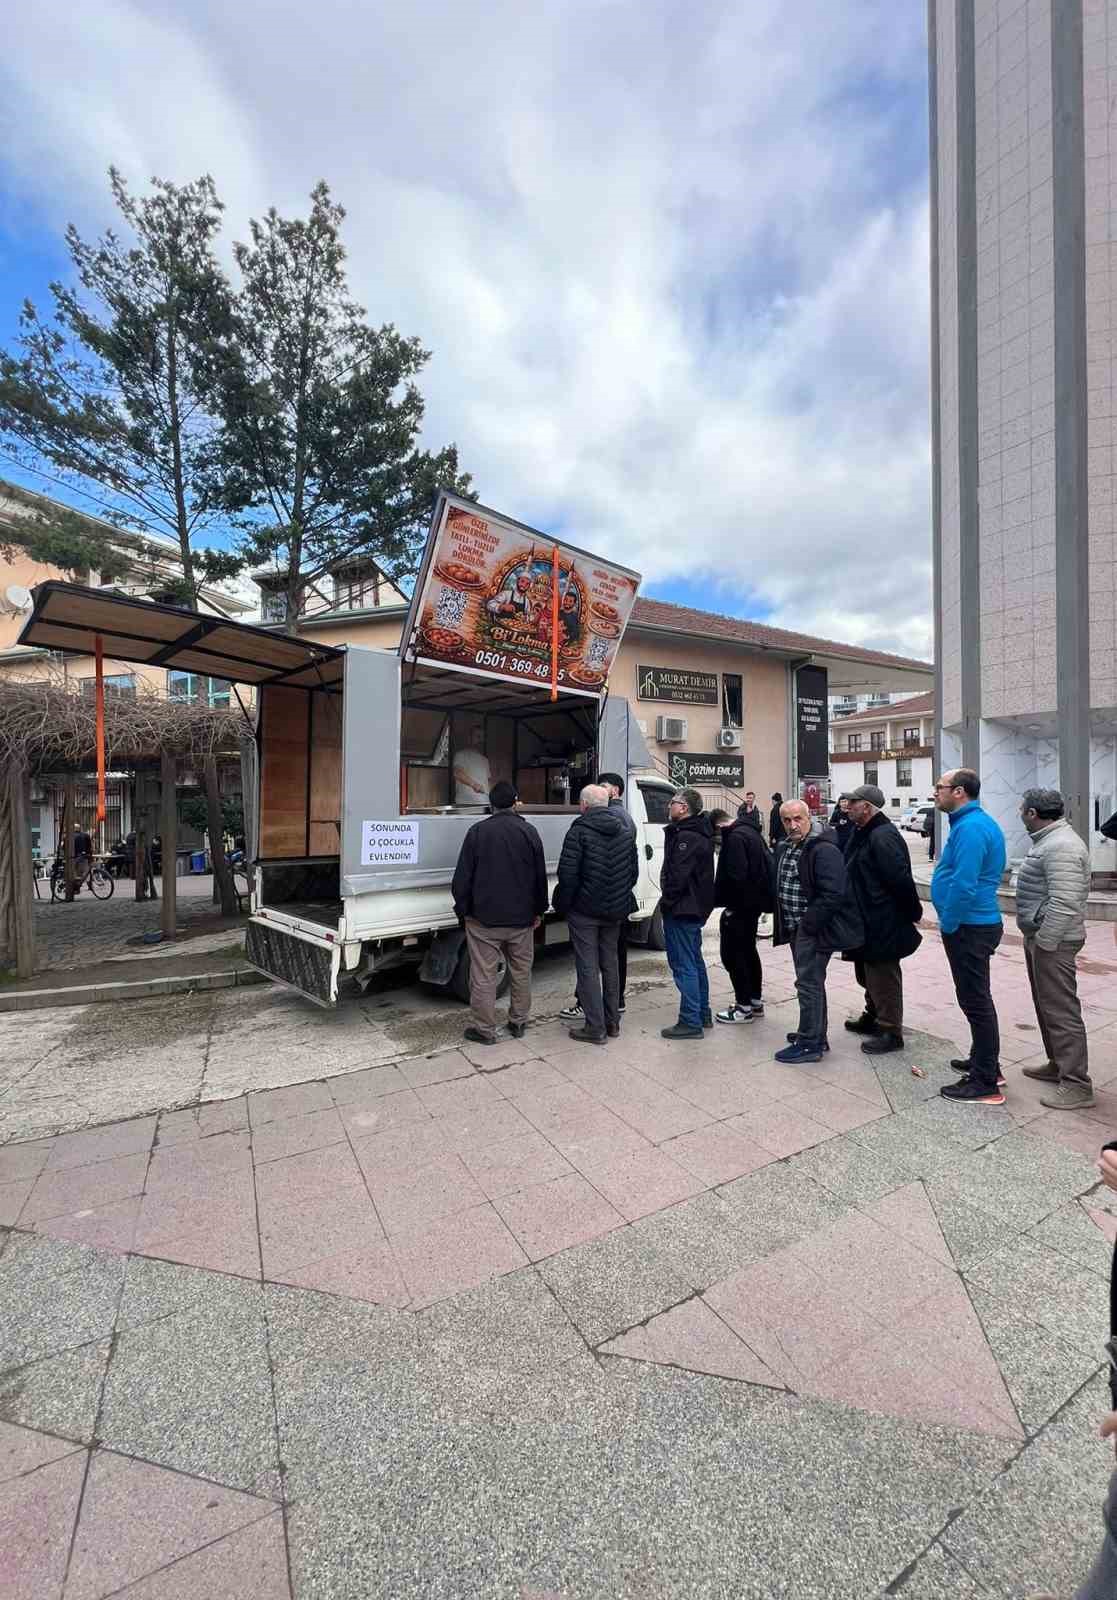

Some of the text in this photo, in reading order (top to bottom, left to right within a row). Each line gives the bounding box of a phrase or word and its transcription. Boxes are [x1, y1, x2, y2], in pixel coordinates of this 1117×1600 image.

[475, 650, 507, 669] 0501
[509, 658, 532, 674] 369
[534, 664, 549, 677] 48
[659, 673, 689, 685] MURAT
[688, 763, 742, 776] ÇÖZÜM EMLAK
[370, 824, 412, 832] SONUNDA
[378, 838, 414, 848] ÇOCUKLA
